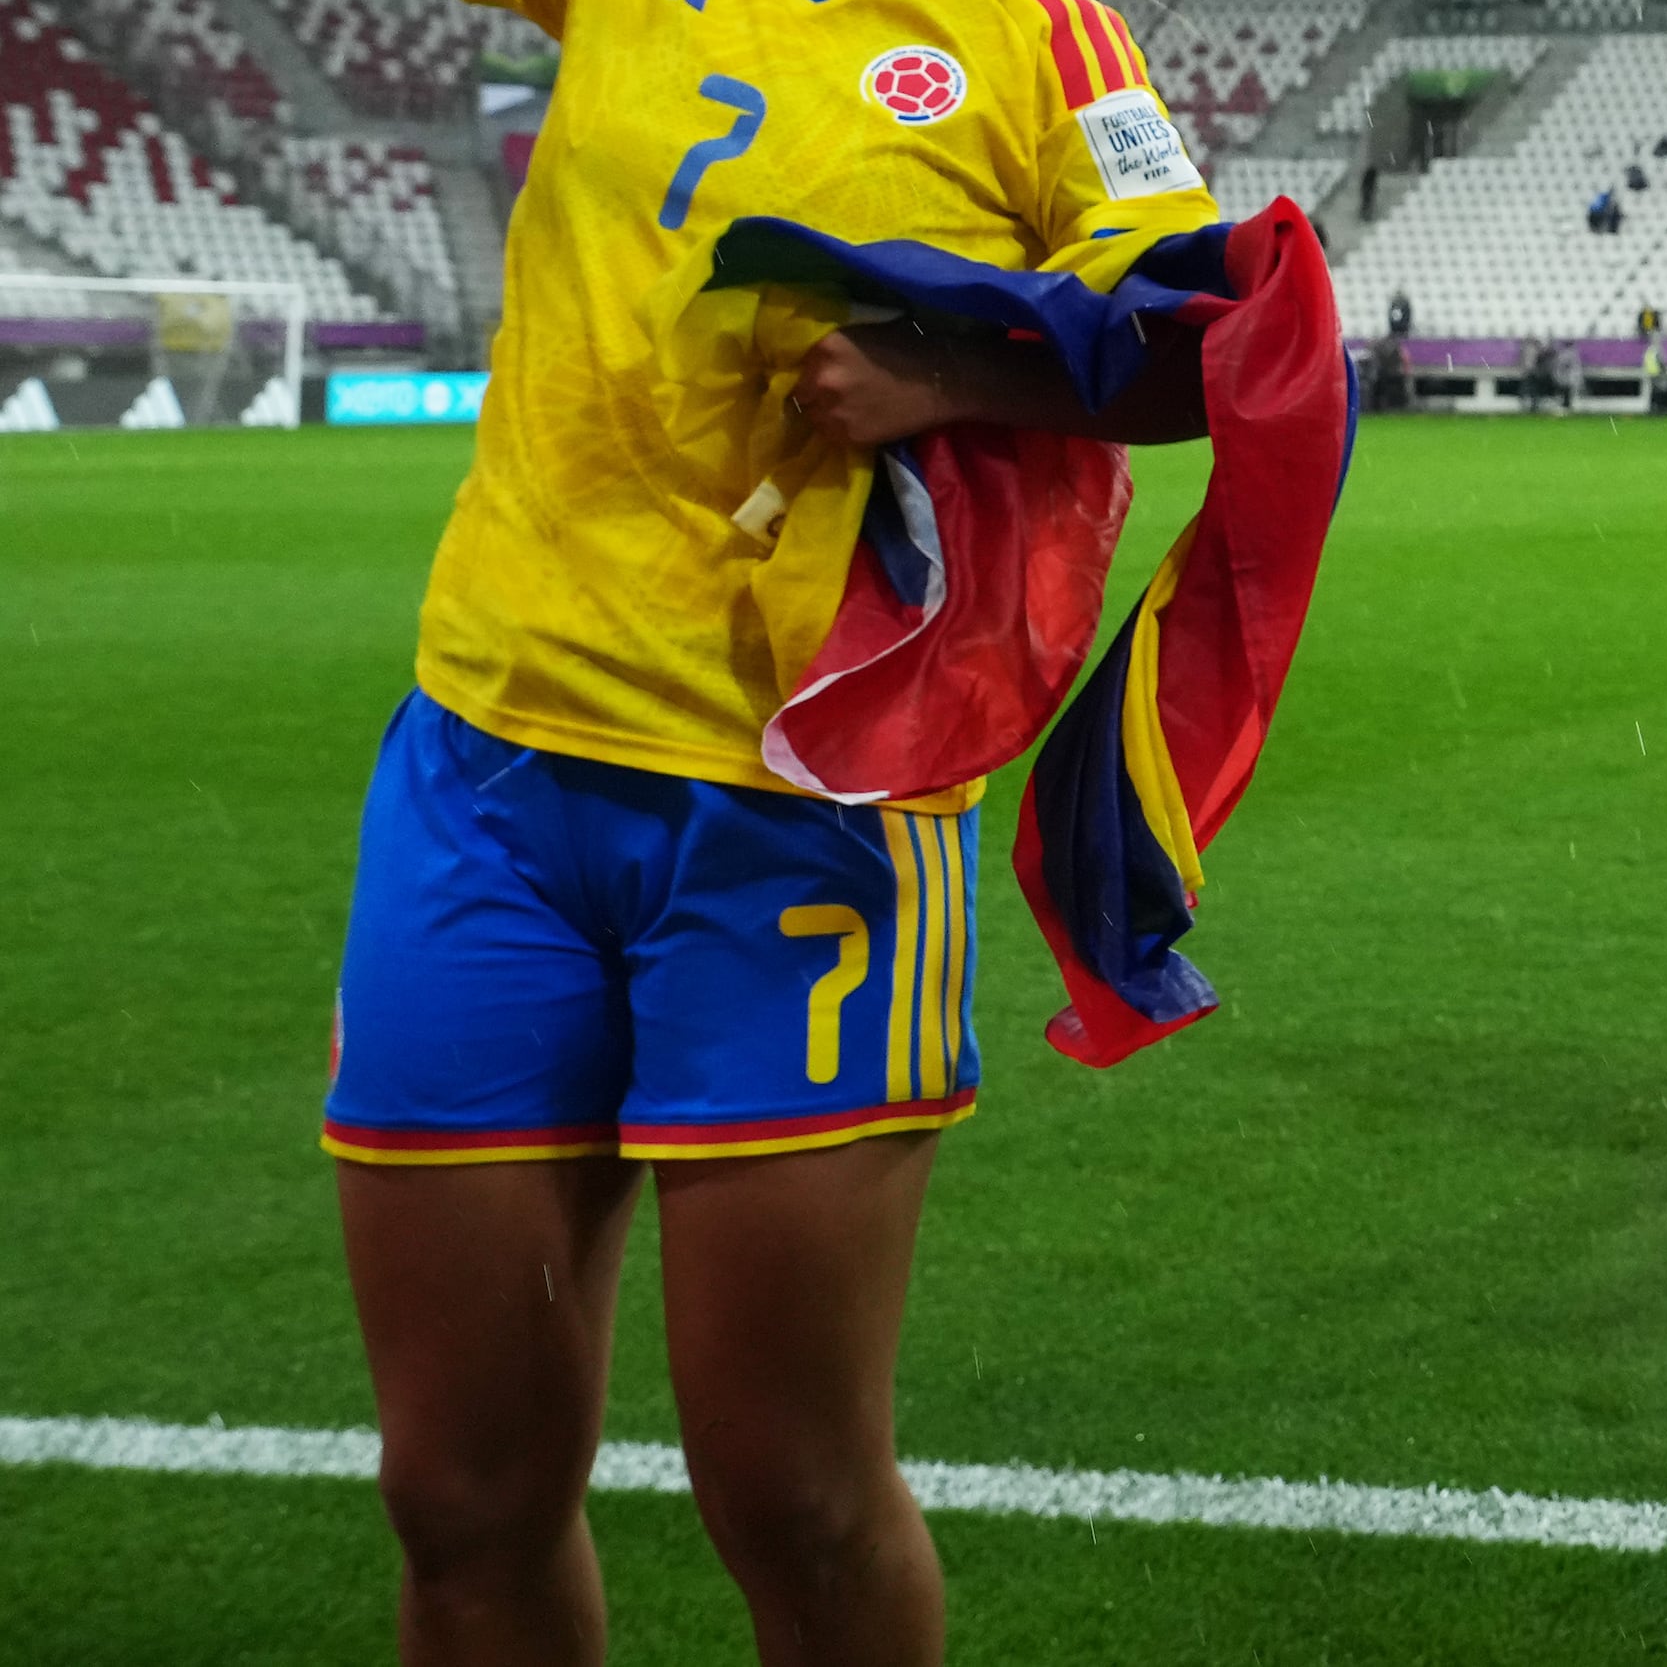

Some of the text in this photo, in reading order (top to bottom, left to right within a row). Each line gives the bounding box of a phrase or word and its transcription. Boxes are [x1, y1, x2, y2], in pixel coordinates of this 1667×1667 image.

[1101, 104, 1159, 132] FOOTBALL
[658, 72, 768, 231] 7
[1108, 119, 1171, 153] UNITES
[1117, 155, 1144, 176] the
[1143, 165, 1171, 181] FIFA
[778, 902, 870, 1085] 7
